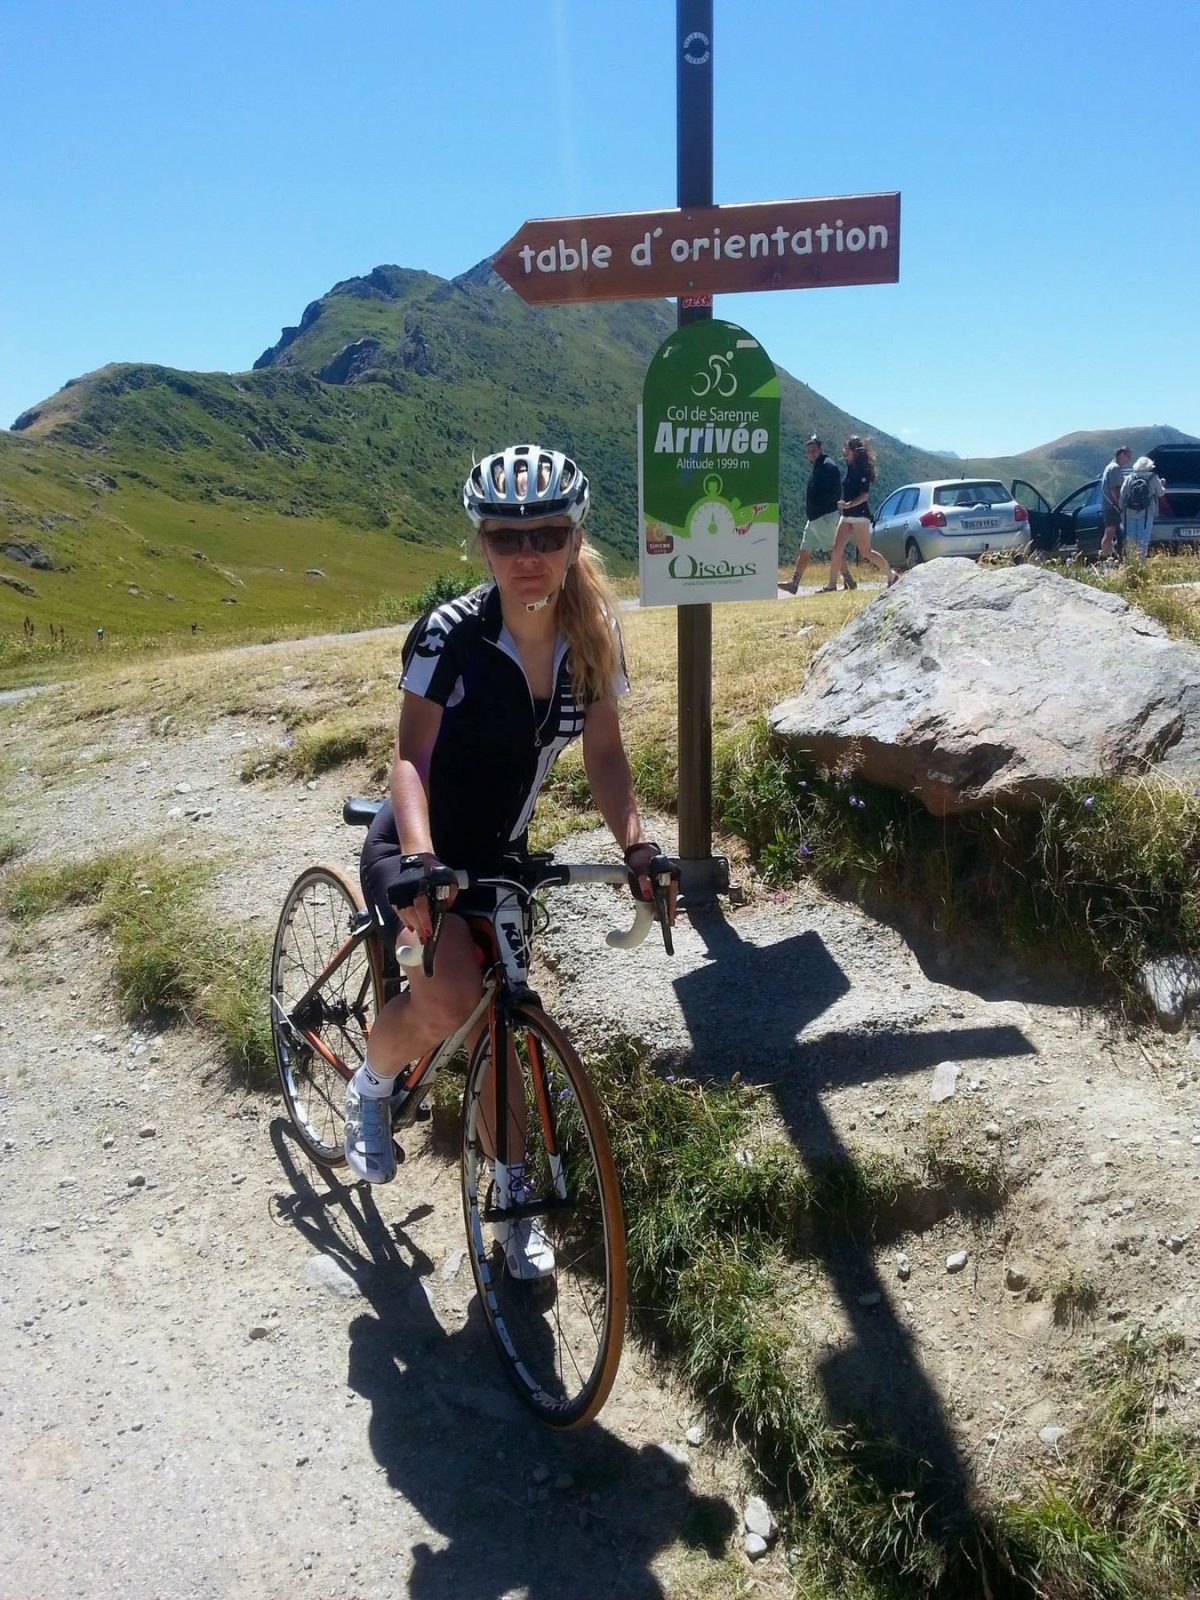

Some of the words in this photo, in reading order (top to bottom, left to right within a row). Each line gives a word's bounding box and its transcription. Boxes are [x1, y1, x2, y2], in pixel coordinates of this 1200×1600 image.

[518, 238, 612, 274] table
[667, 405, 688, 421] Col
[690, 405, 707, 421] de
[709, 406, 760, 422] Sarenne
[654, 422, 769, 454] Arrivée
[676, 458, 714, 470] Altitude
[716, 458, 739, 470] 1999
[740, 460, 750, 469] m
[668, 554, 757, 578] Oisans
